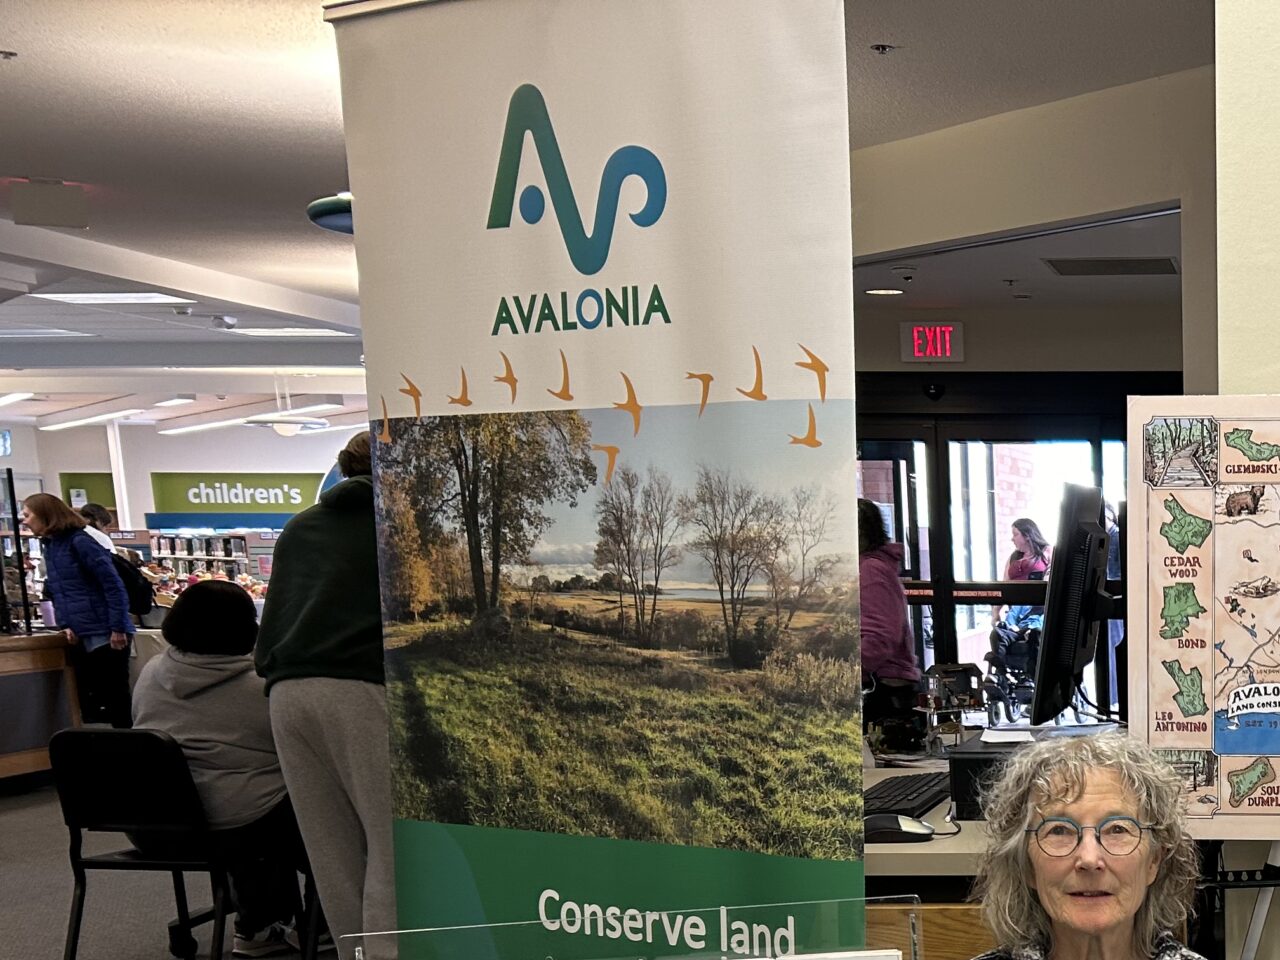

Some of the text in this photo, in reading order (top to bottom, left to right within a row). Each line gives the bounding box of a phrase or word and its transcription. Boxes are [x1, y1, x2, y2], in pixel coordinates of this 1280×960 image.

[491, 283, 672, 336] AVALONIA
[912, 326, 953, 357] EXIT
[187, 483, 302, 505] children's
[1163, 556, 1203, 568] CEDAR
[1168, 568, 1198, 578] WOOD
[1177, 639, 1207, 648] BOND
[1230, 702, 1254, 713] LAND
[1155, 711, 1173, 721] LEO
[1154, 721, 1207, 732] ANTONINO
[1244, 719, 1264, 728] EST
[538, 889, 795, 957] Conserve land
